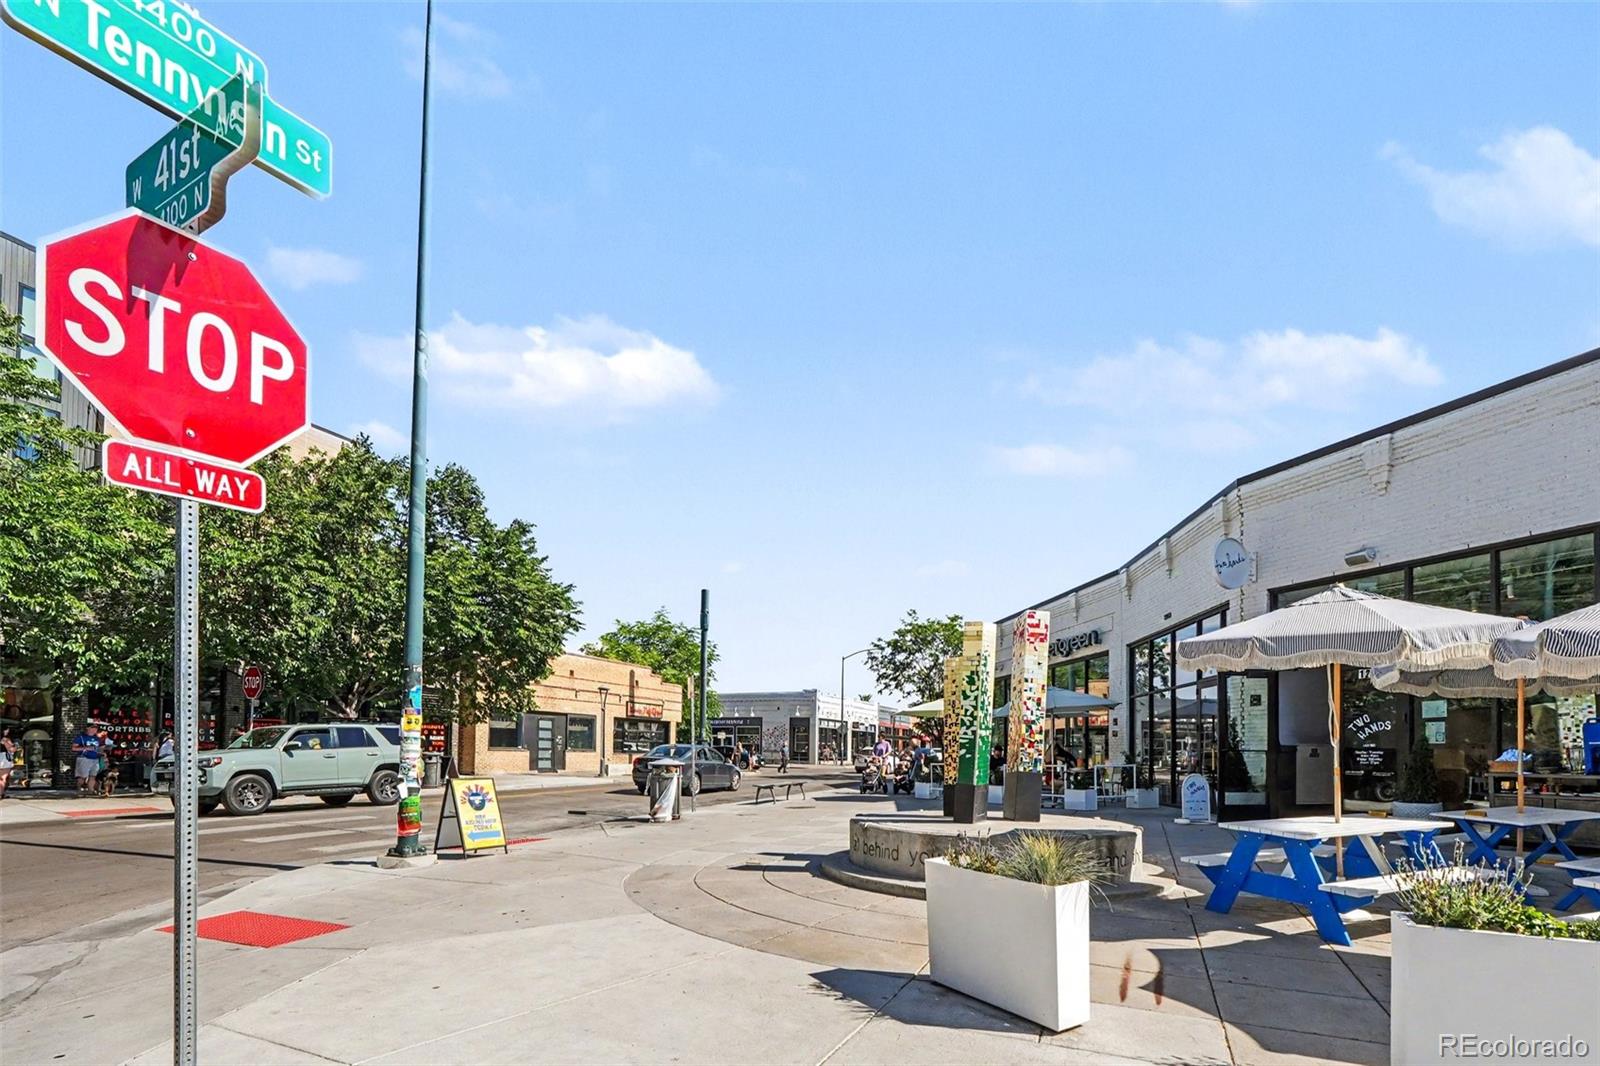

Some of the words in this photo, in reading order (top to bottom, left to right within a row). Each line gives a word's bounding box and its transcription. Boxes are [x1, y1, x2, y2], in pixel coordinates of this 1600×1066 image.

[235, 52, 254, 88] N
[132, 176, 142, 204] W
[154, 123, 201, 192] 41st
[295, 139, 323, 173] St
[194, 181, 203, 210] N
[64, 267, 295, 406] STOP
[122, 452, 181, 488] ALL
[194, 470, 251, 502] WAY
[243, 676, 261, 691] STOP
[1347, 714, 1370, 731] TWO
[1357, 720, 1392, 740] HANDS
[863, 838, 900, 862] behind
